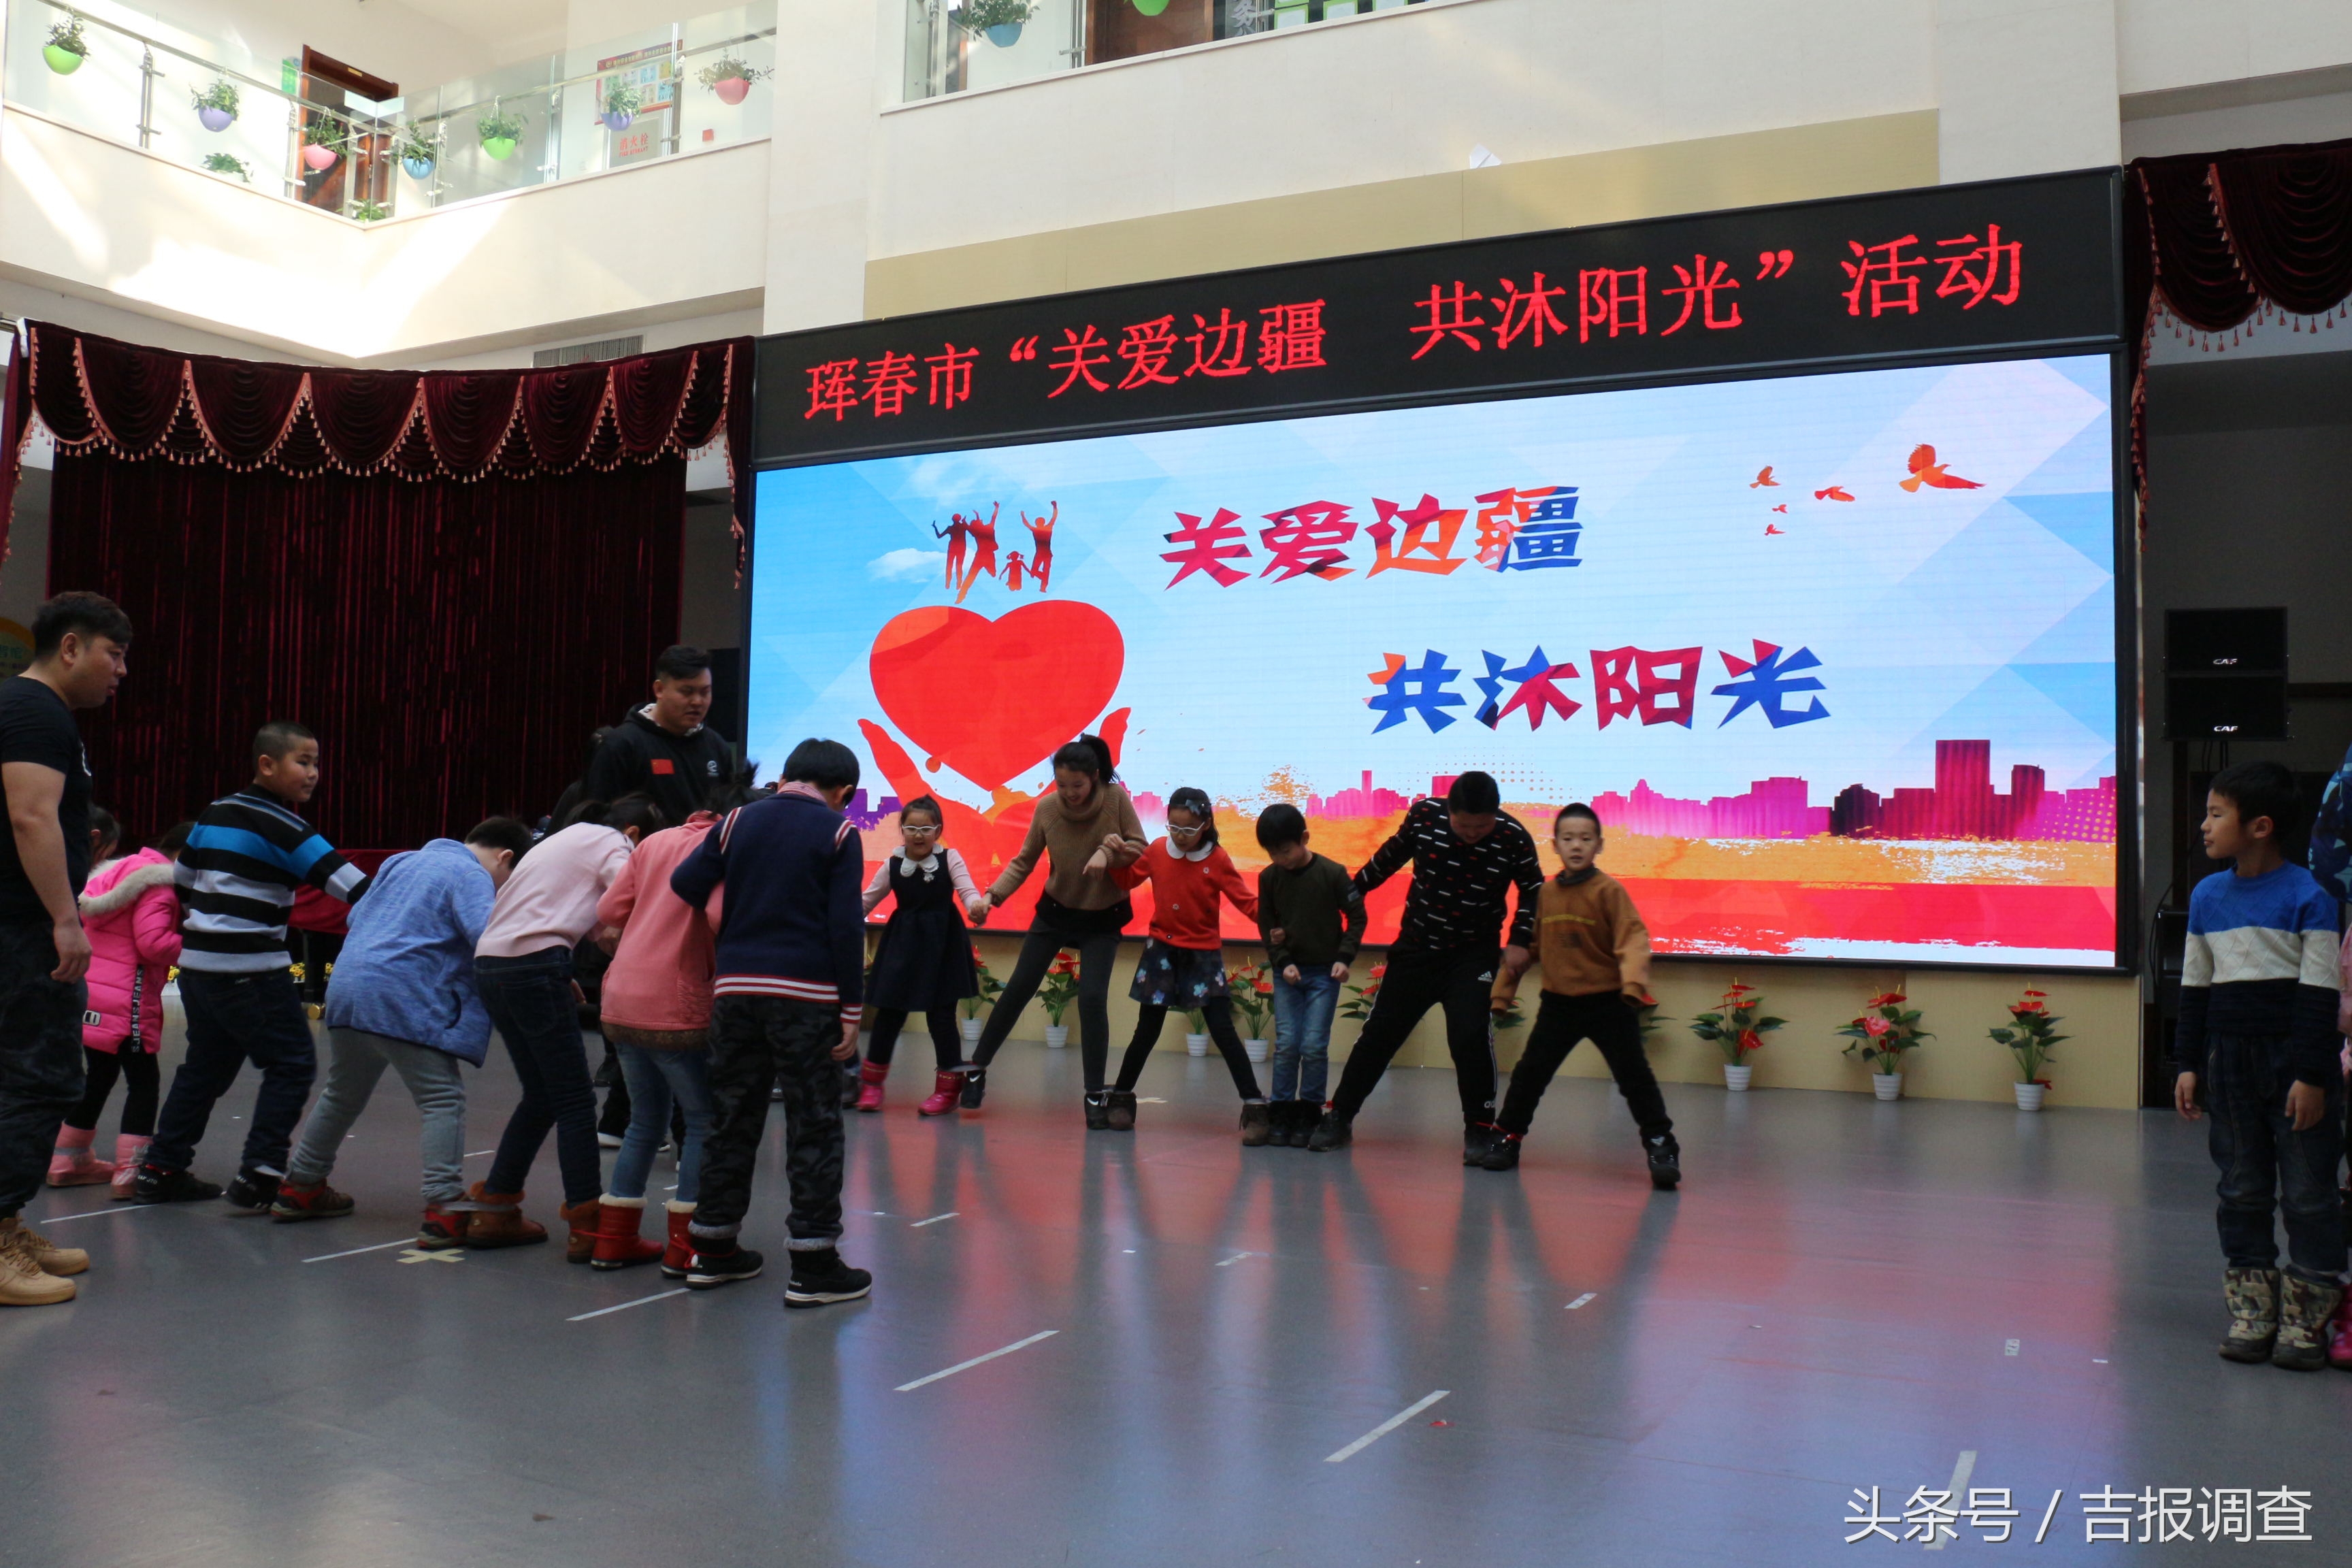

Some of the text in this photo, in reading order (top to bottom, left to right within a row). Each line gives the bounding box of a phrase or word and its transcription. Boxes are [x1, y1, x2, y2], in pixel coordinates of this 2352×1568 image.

[1159, 485, 1582, 591] 关爱边疆
[1363, 638, 1831, 734] 共沐阳光
